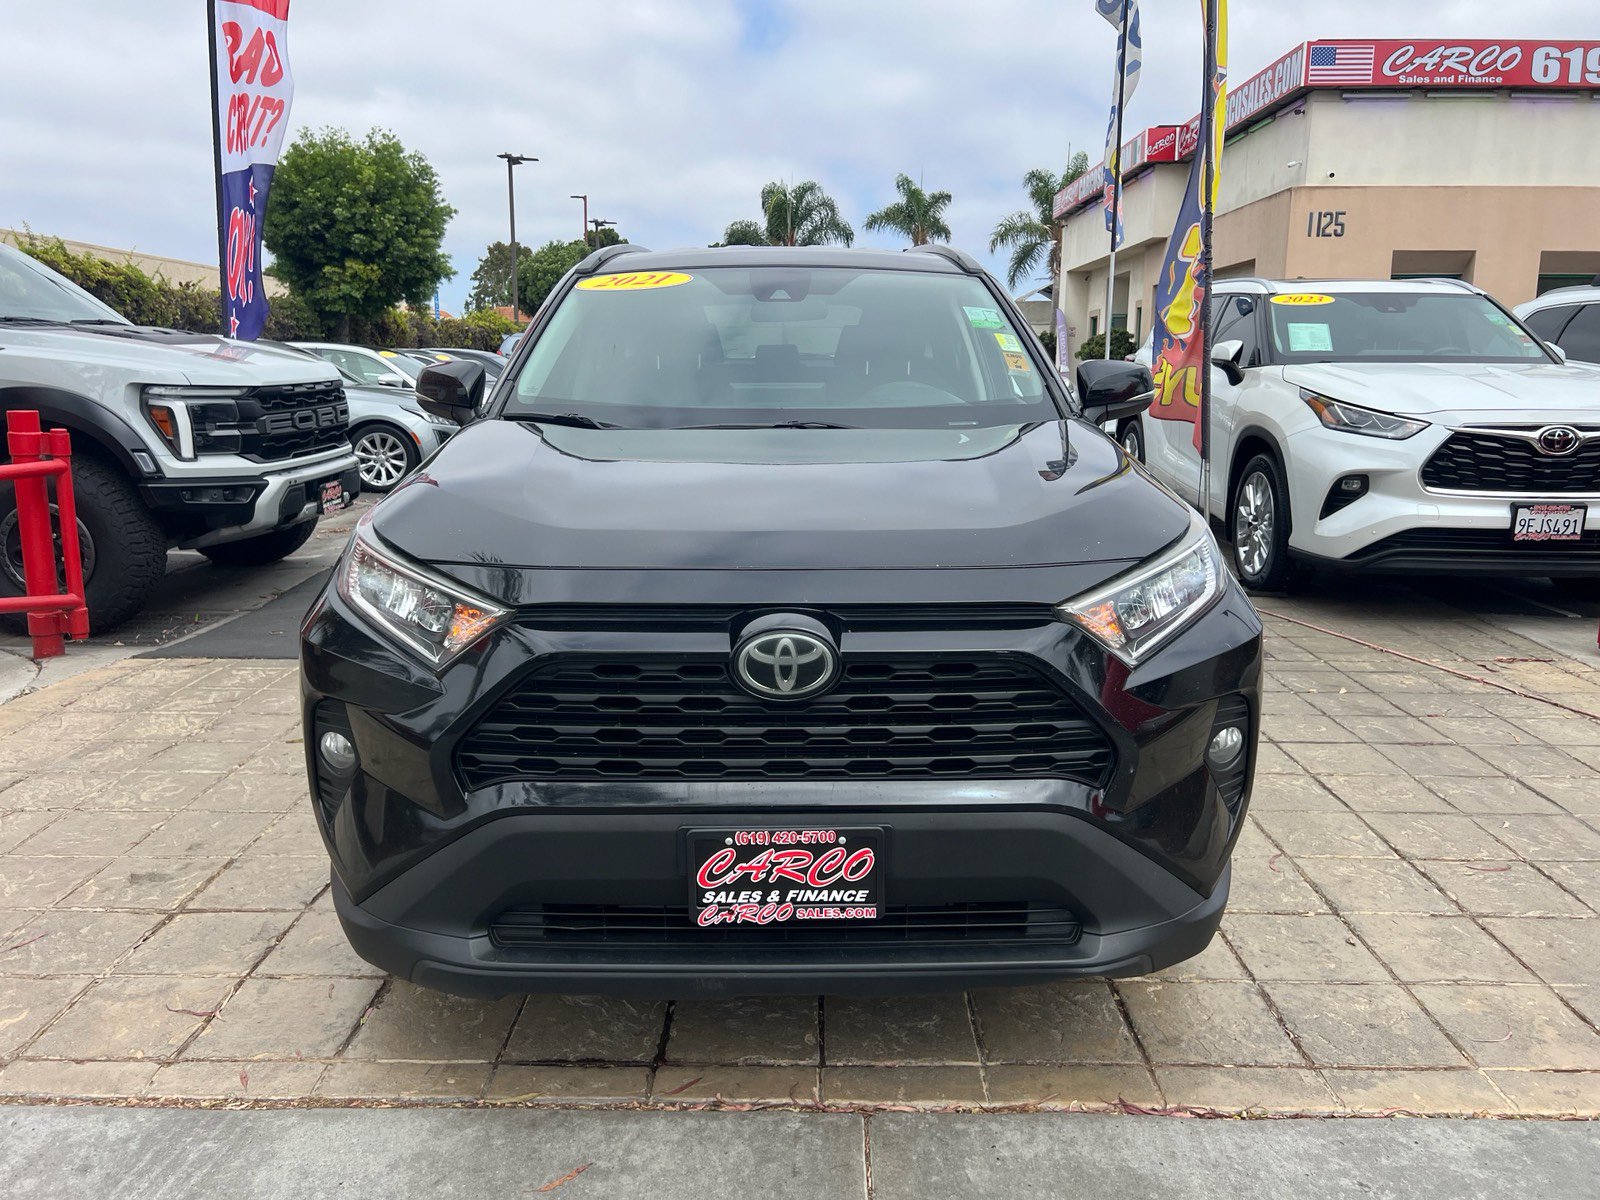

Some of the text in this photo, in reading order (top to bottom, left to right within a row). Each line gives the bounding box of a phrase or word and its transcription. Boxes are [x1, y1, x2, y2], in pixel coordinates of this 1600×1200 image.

[1382, 44, 1523, 77] CARCO
[1399, 75, 1503, 83] Sales and Finance
[1307, 211, 1346, 237] 1125
[593, 273, 674, 288] 2021
[1282, 295, 1325, 304] 2023
[264, 403, 350, 434] FORD
[1517, 518, 1578, 535] 9EJS491
[735, 831, 837, 846] (619) 420-5700
[697, 847, 875, 888] CARCO
[702, 890, 869, 904] SALES & FINANCE
[697, 903, 877, 927] CARCO SALES.COM
